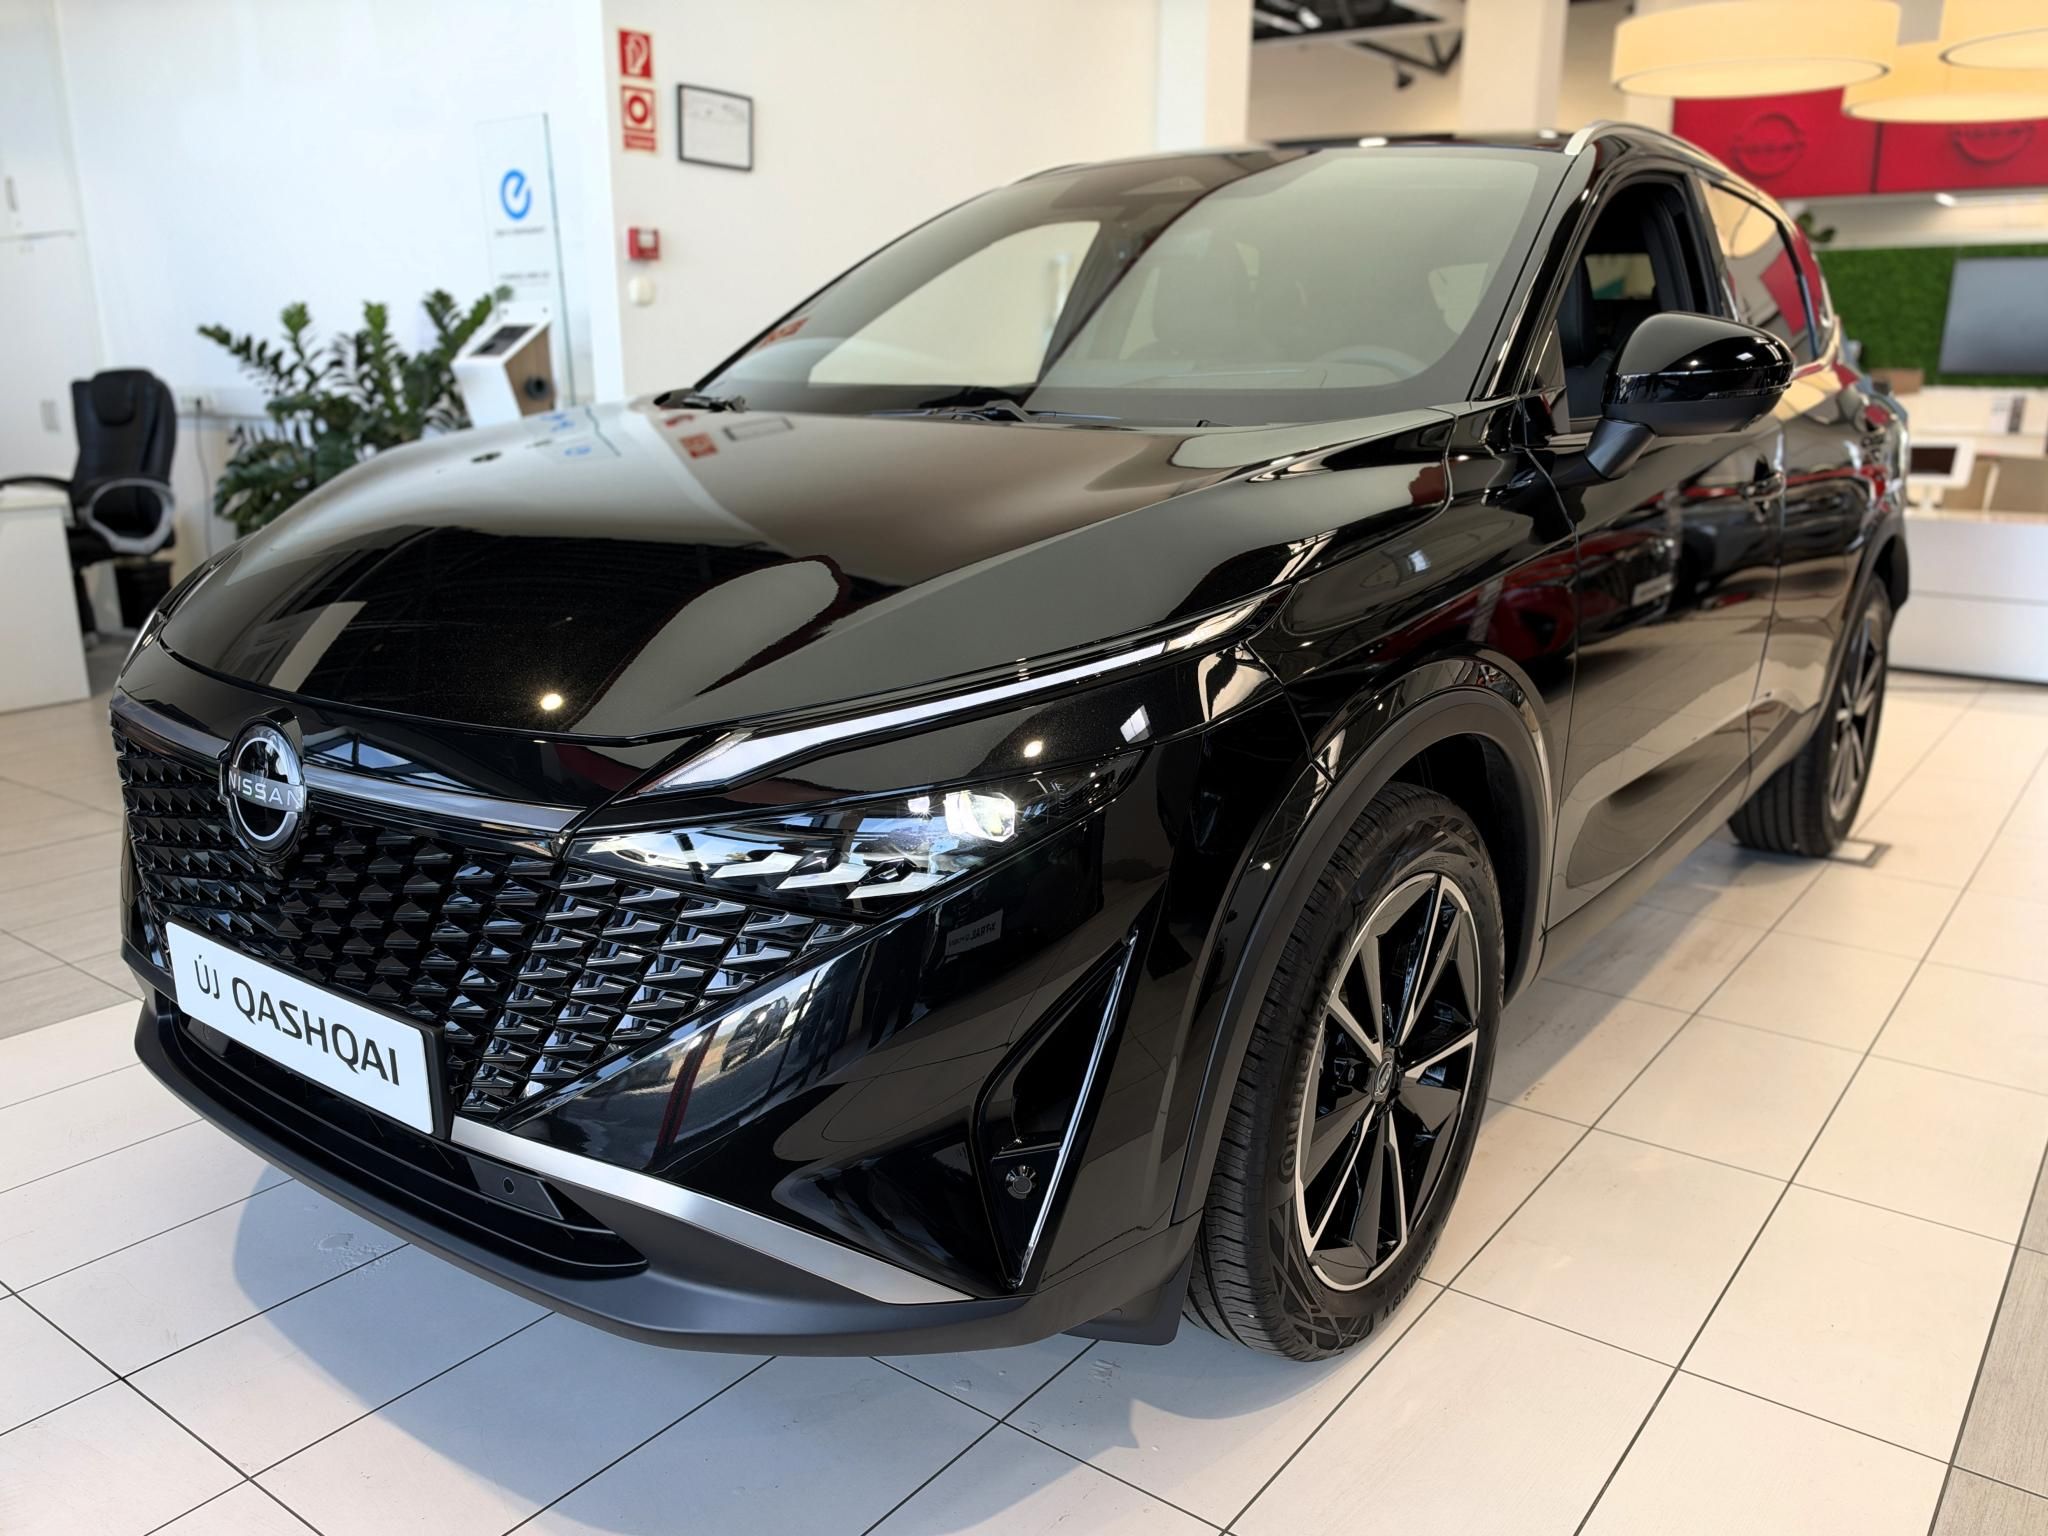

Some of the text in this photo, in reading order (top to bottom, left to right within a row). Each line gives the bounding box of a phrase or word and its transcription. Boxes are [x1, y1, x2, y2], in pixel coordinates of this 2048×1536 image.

[228, 768, 301, 808] NISSAN
[194, 954, 400, 1086] ÚJ QASHQAI
